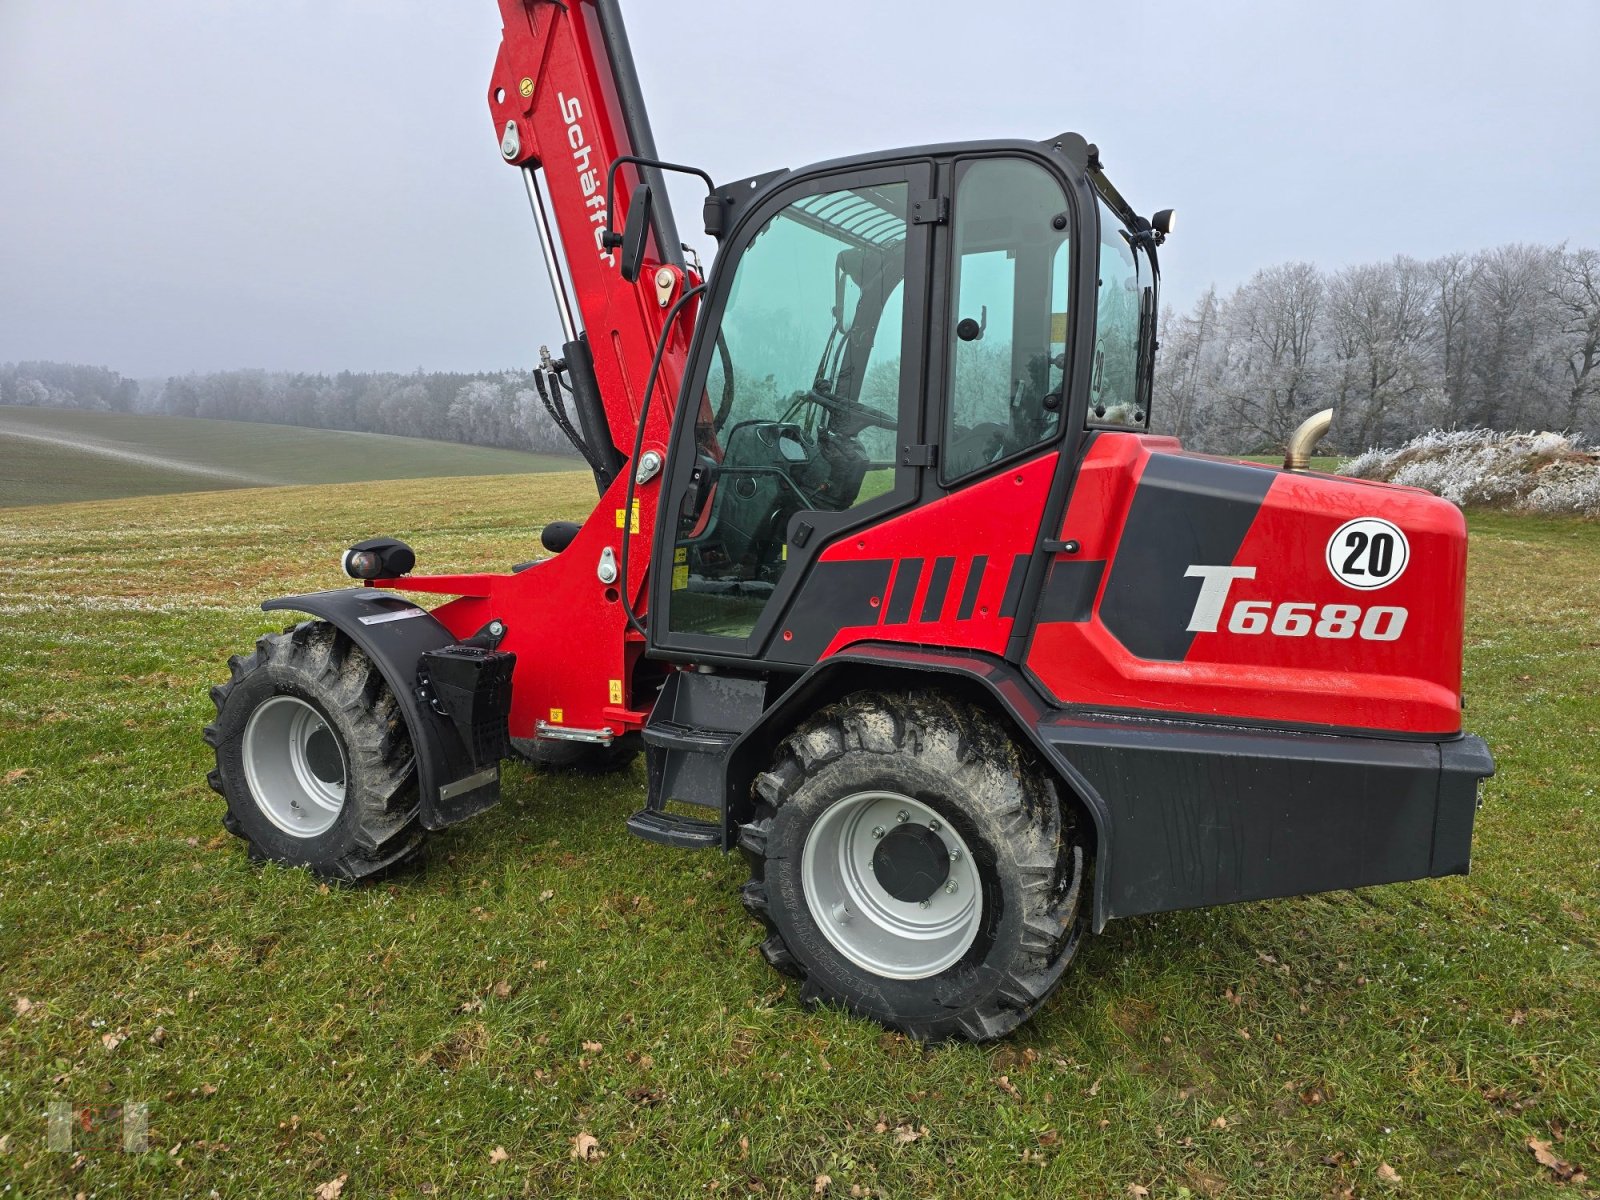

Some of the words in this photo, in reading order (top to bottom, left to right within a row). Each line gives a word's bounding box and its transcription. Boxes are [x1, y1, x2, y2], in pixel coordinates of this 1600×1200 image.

[557, 91, 615, 268] Schäffer
[1342, 531, 1394, 578] 20
[1183, 564, 1409, 641] T6680
